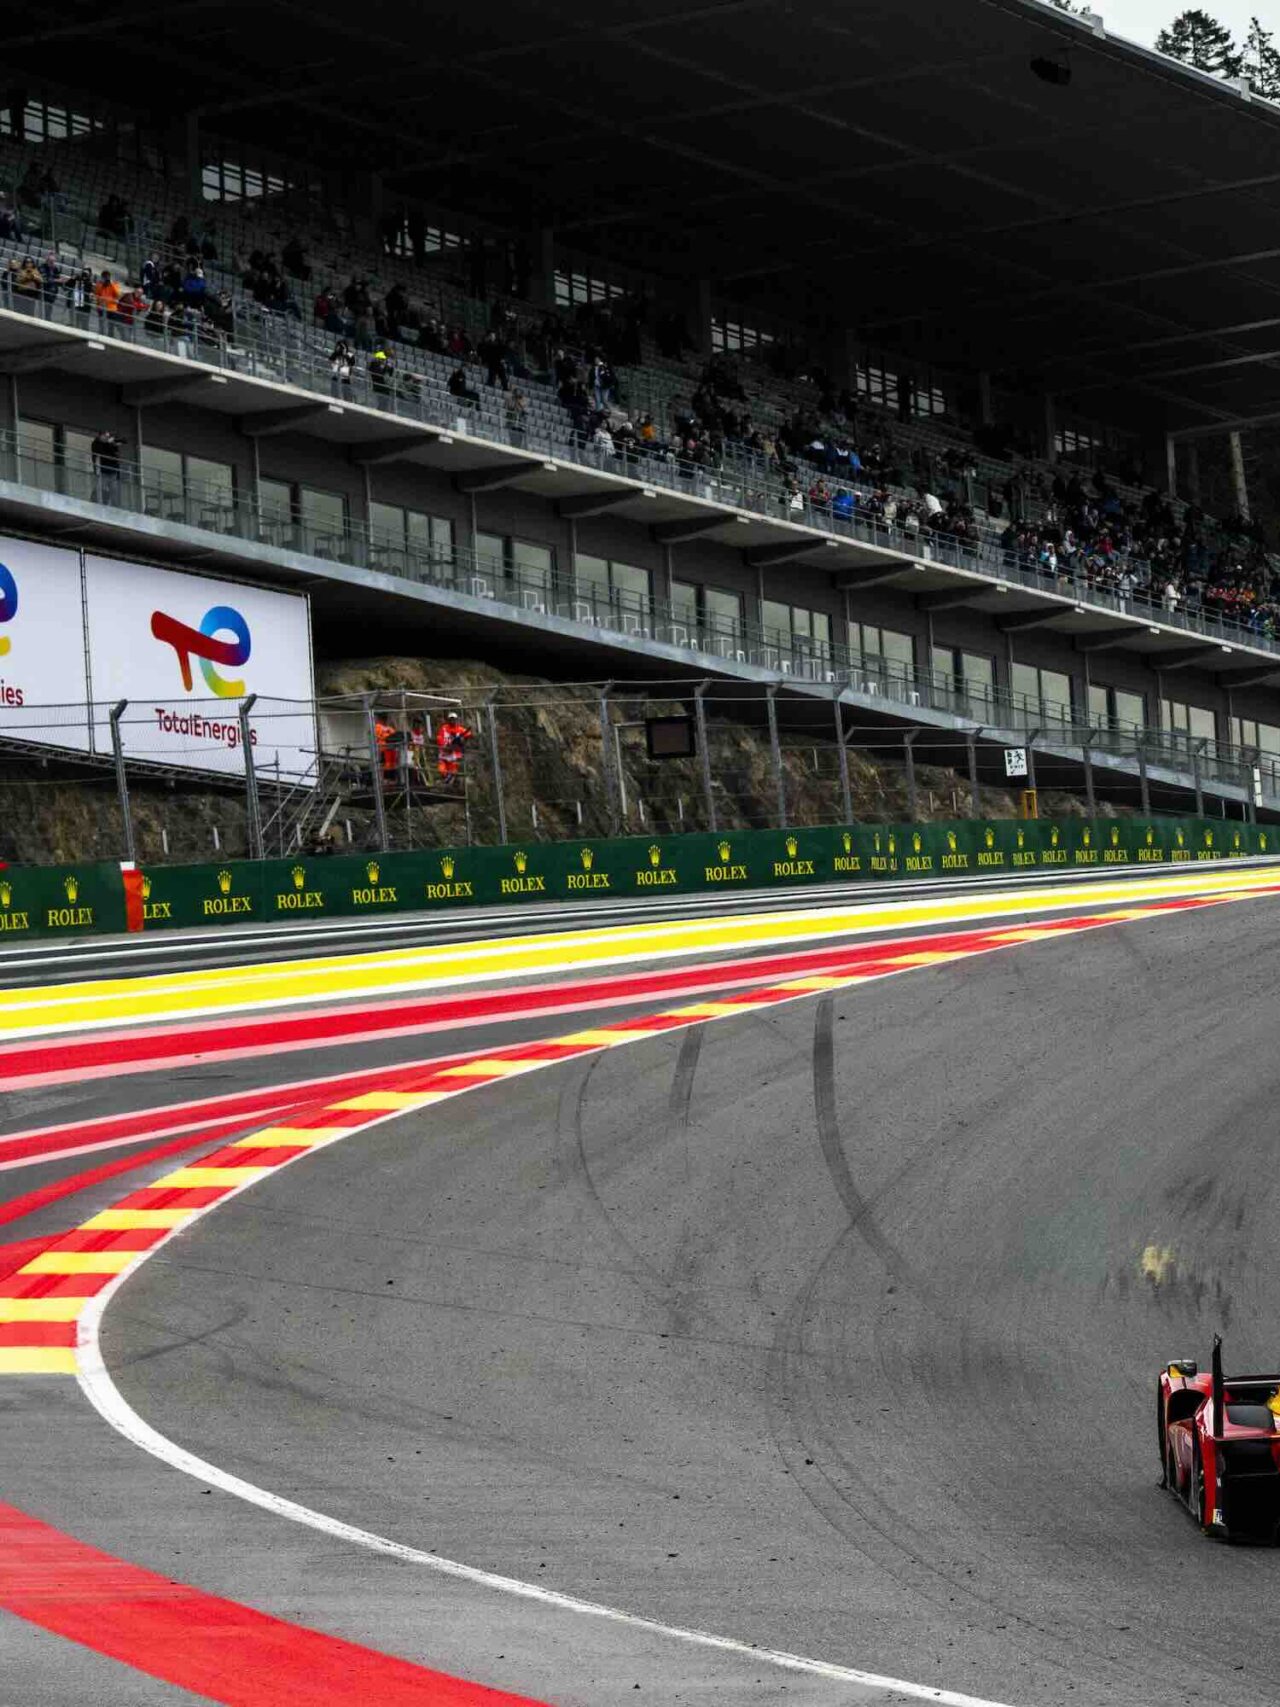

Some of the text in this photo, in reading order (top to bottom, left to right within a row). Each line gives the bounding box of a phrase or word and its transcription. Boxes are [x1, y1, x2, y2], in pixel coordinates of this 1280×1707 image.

[155, 708, 257, 748] TotalEnergis
[834, 856, 861, 871] ROLEX
[978, 852, 1004, 865] ROLEX
[705, 865, 747, 881] ROLEX
[774, 860, 815, 875] ROLEX
[501, 876, 545, 893] ROLEX
[567, 873, 609, 889] ROLEX
[637, 869, 677, 885] ROLEX
[352, 888, 397, 904] ROLEX
[427, 882, 472, 899] ROLEX
[203, 897, 250, 915] ROLEX
[277, 893, 323, 909] ROLEX
[48, 908, 93, 927] ROLEX
